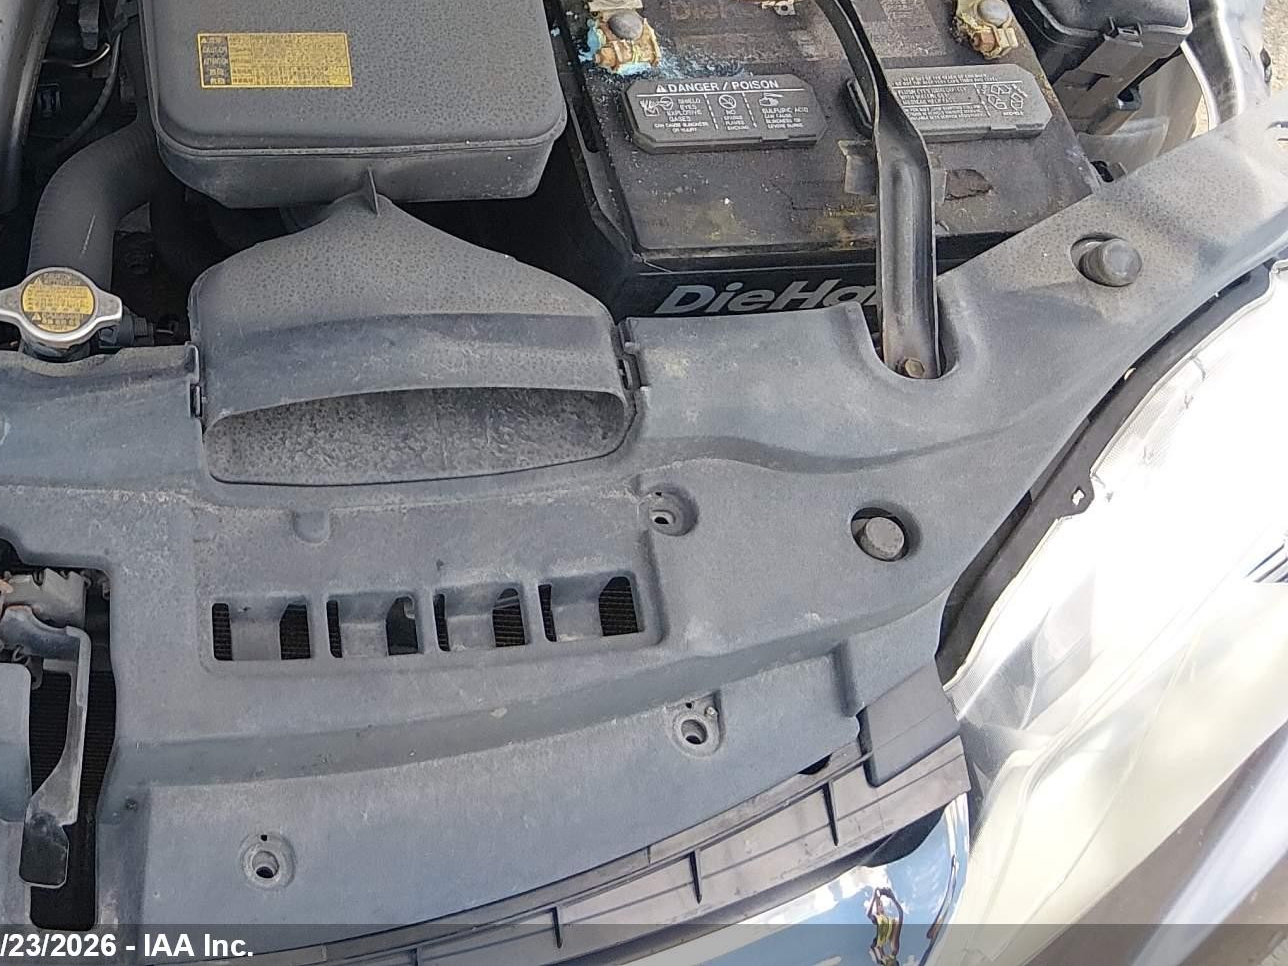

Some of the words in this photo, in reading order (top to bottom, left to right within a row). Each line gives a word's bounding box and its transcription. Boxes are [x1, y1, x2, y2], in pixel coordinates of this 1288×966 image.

[667, 82, 720, 93] DANGER
[731, 79, 779, 90] POISON
[654, 278, 879, 315] DieHa
